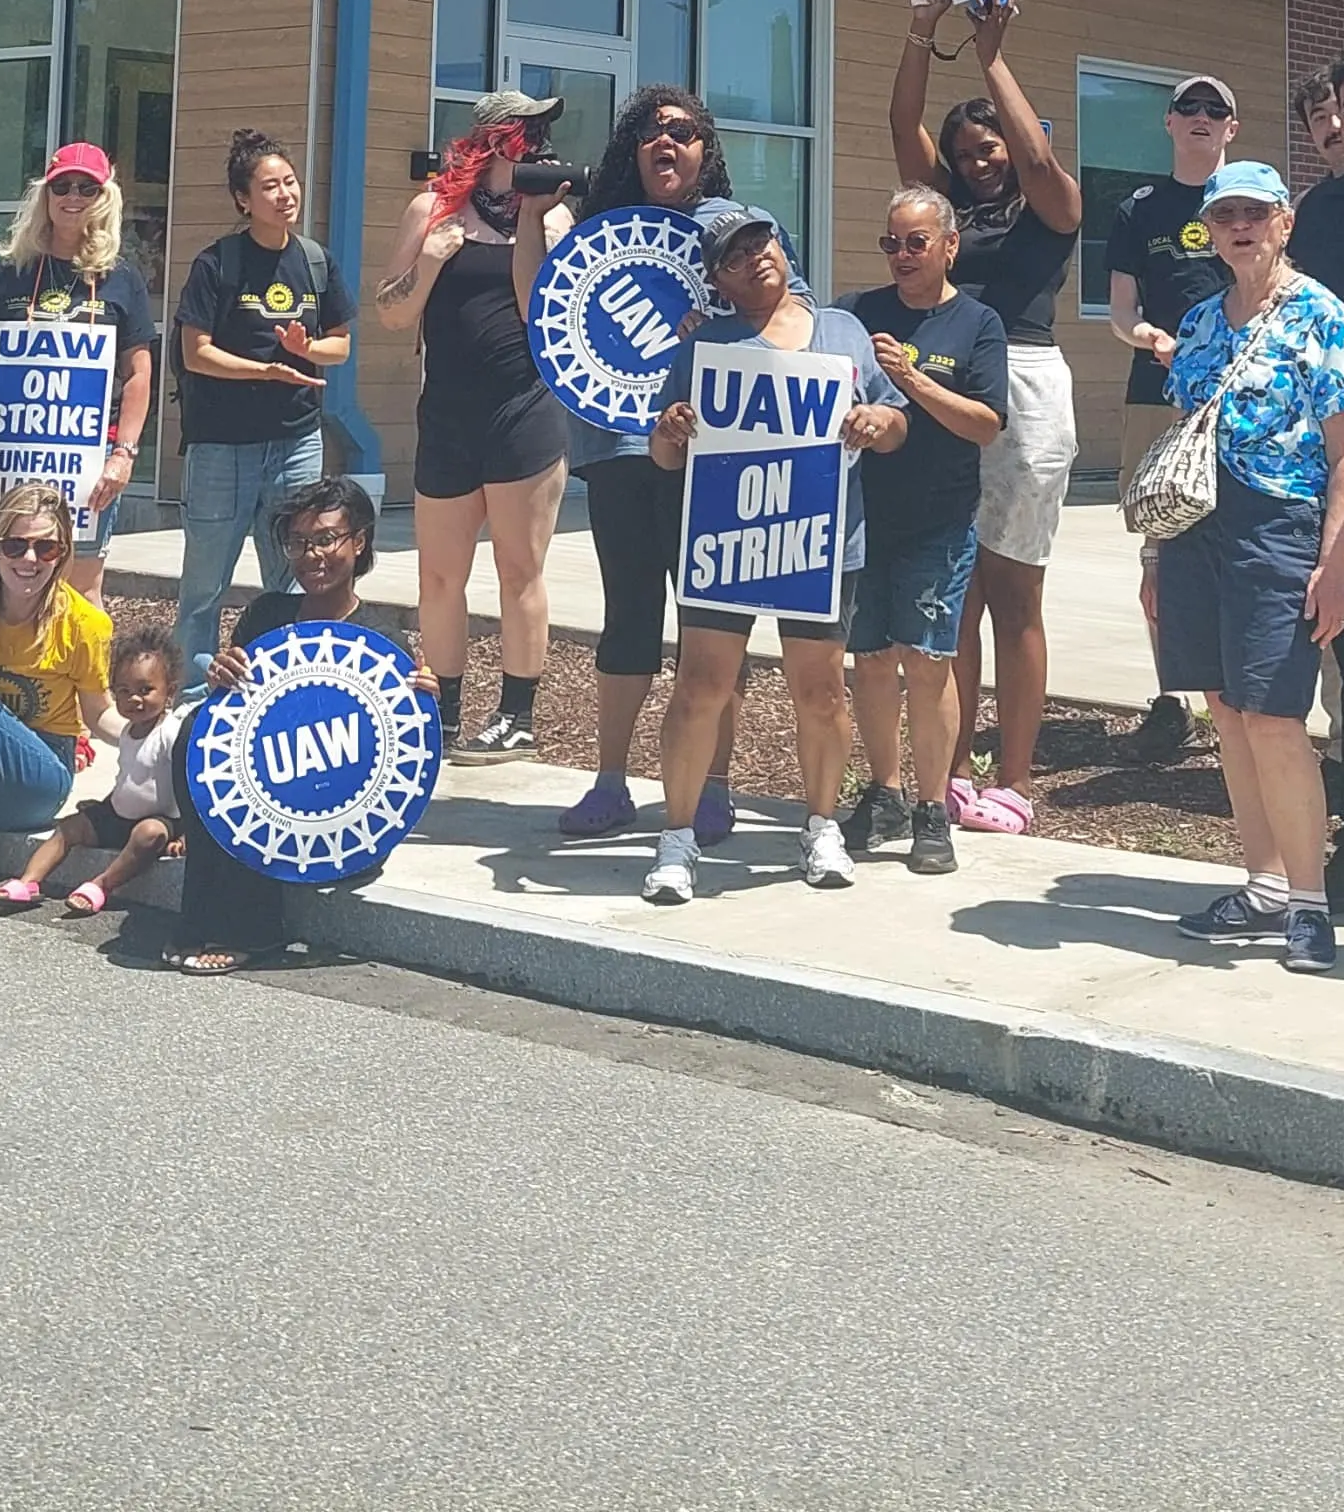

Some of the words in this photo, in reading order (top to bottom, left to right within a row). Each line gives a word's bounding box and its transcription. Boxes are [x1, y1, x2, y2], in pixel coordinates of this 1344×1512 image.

[659, 252, 677, 263] AND
[1147, 235, 1173, 247] LOCAL
[599, 273, 680, 361] UAW
[23, 369, 70, 401] ON
[700, 367, 840, 437] UAW
[737, 459, 792, 521] ON
[691, 513, 830, 589] STRIKE
[259, 682, 276, 698] AND
[278, 665, 341, 683] AGRICULTURAL
[344, 671, 384, 706] IMPLEMENT
[262, 712, 359, 784] UAW
[382, 708, 396, 753] WORKERS
[385, 756, 394, 769] OF
[362, 773, 388, 809] AMERICA
[262, 808, 293, 829] UNITED
